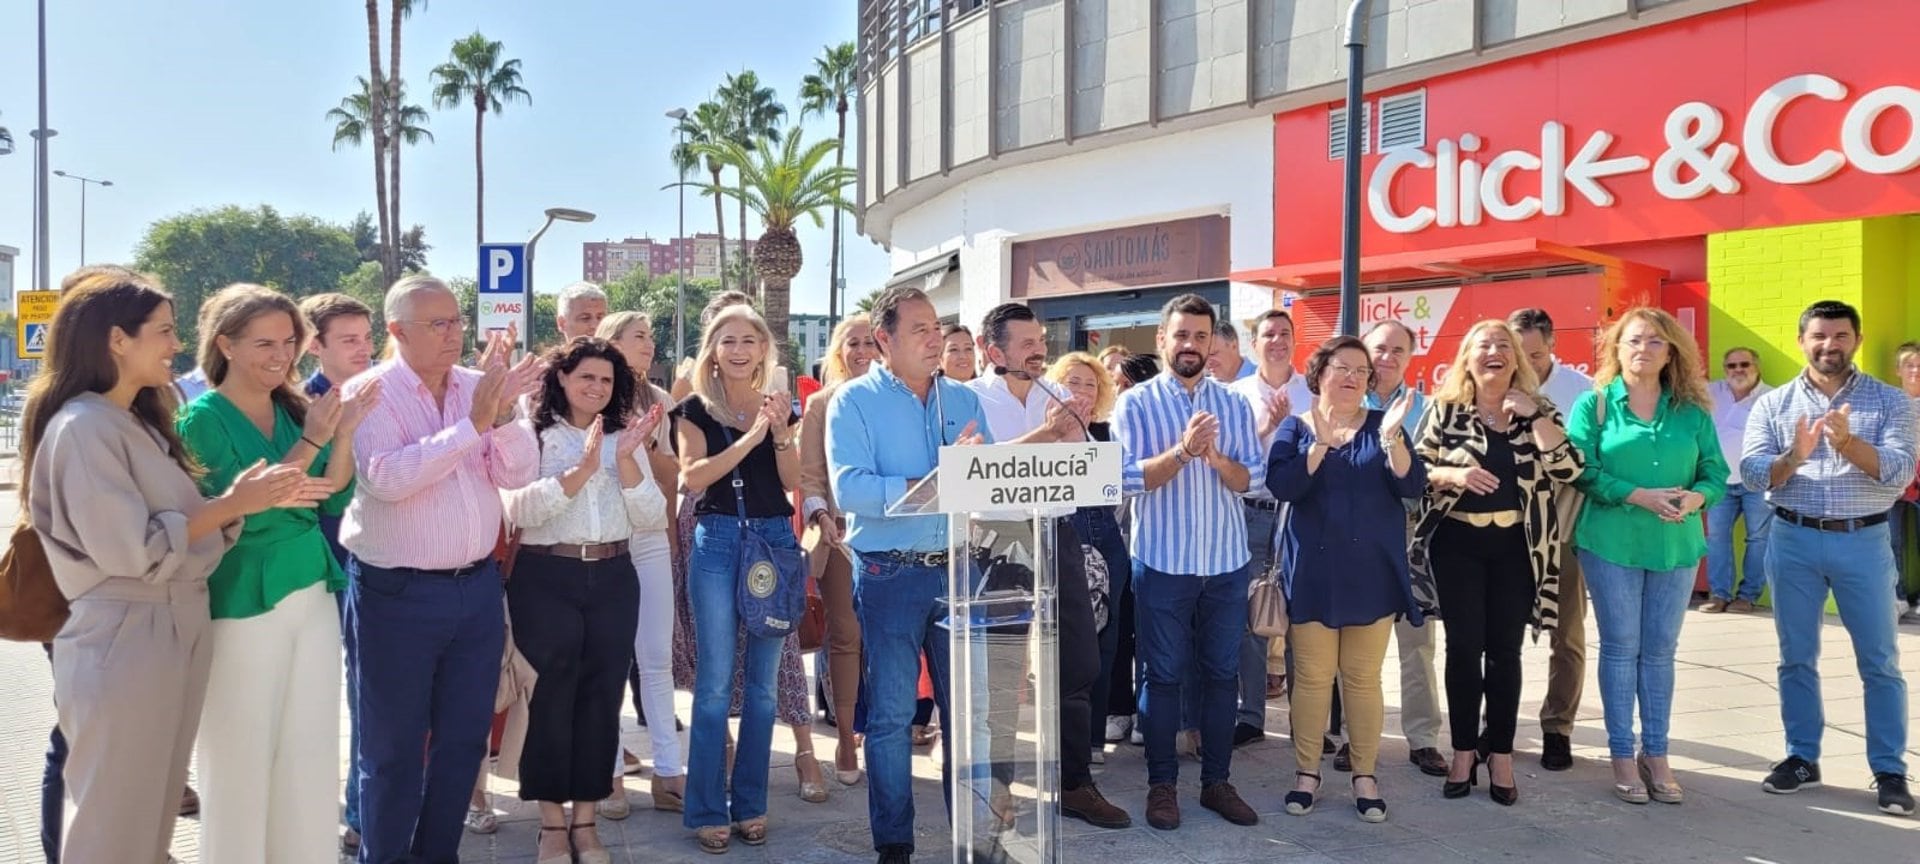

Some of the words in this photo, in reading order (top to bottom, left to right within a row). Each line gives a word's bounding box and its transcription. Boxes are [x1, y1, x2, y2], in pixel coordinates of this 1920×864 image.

[489, 249, 515, 290] P
[493, 303, 522, 314] MAS
[966, 454, 1088, 480] Andalucía
[990, 484, 1075, 505] avanza
